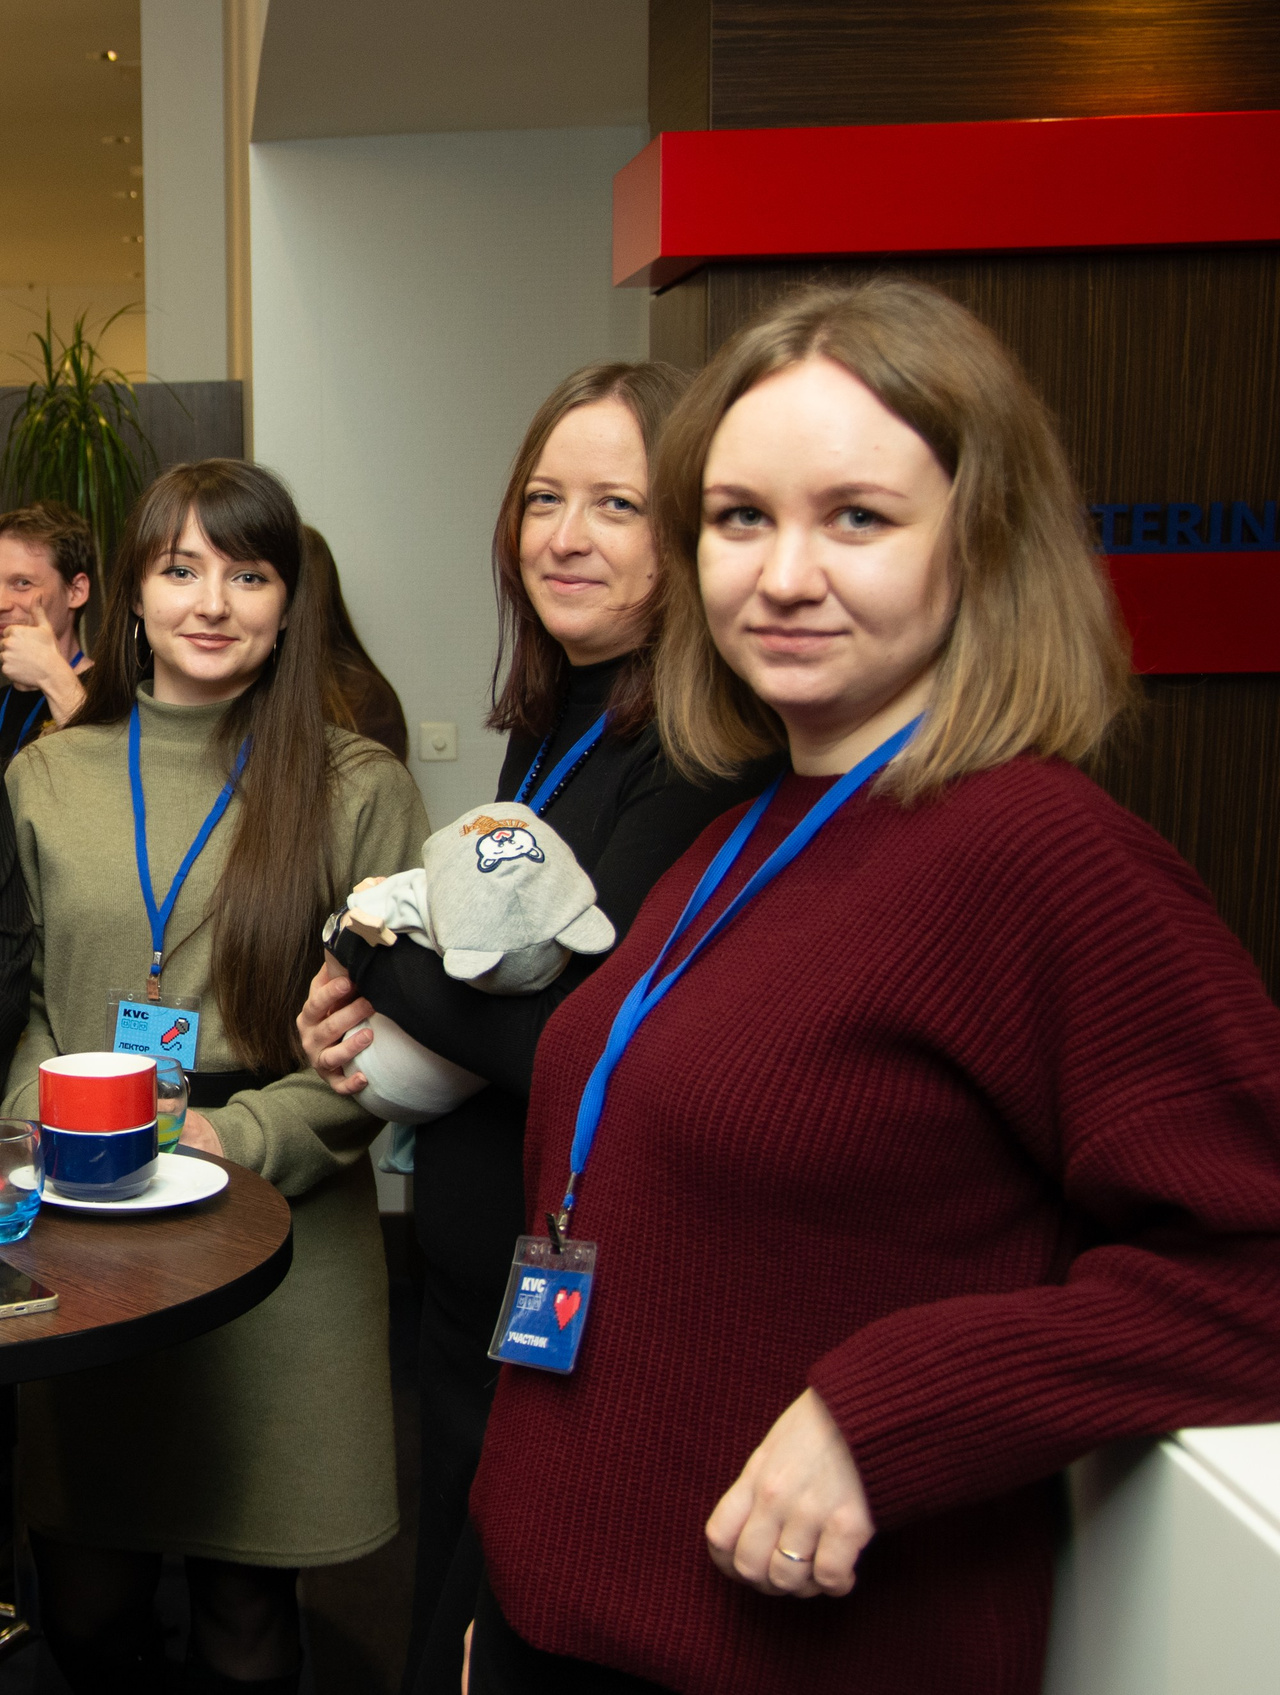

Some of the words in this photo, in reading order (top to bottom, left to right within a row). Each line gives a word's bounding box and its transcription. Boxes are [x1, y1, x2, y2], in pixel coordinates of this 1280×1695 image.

[123, 1008, 150, 1020] KVC
[118, 1042, 150, 1053] ЛЕКТОР
[521, 1276, 547, 1293] KVC
[507, 1331, 549, 1349] УЧАСТНИК
